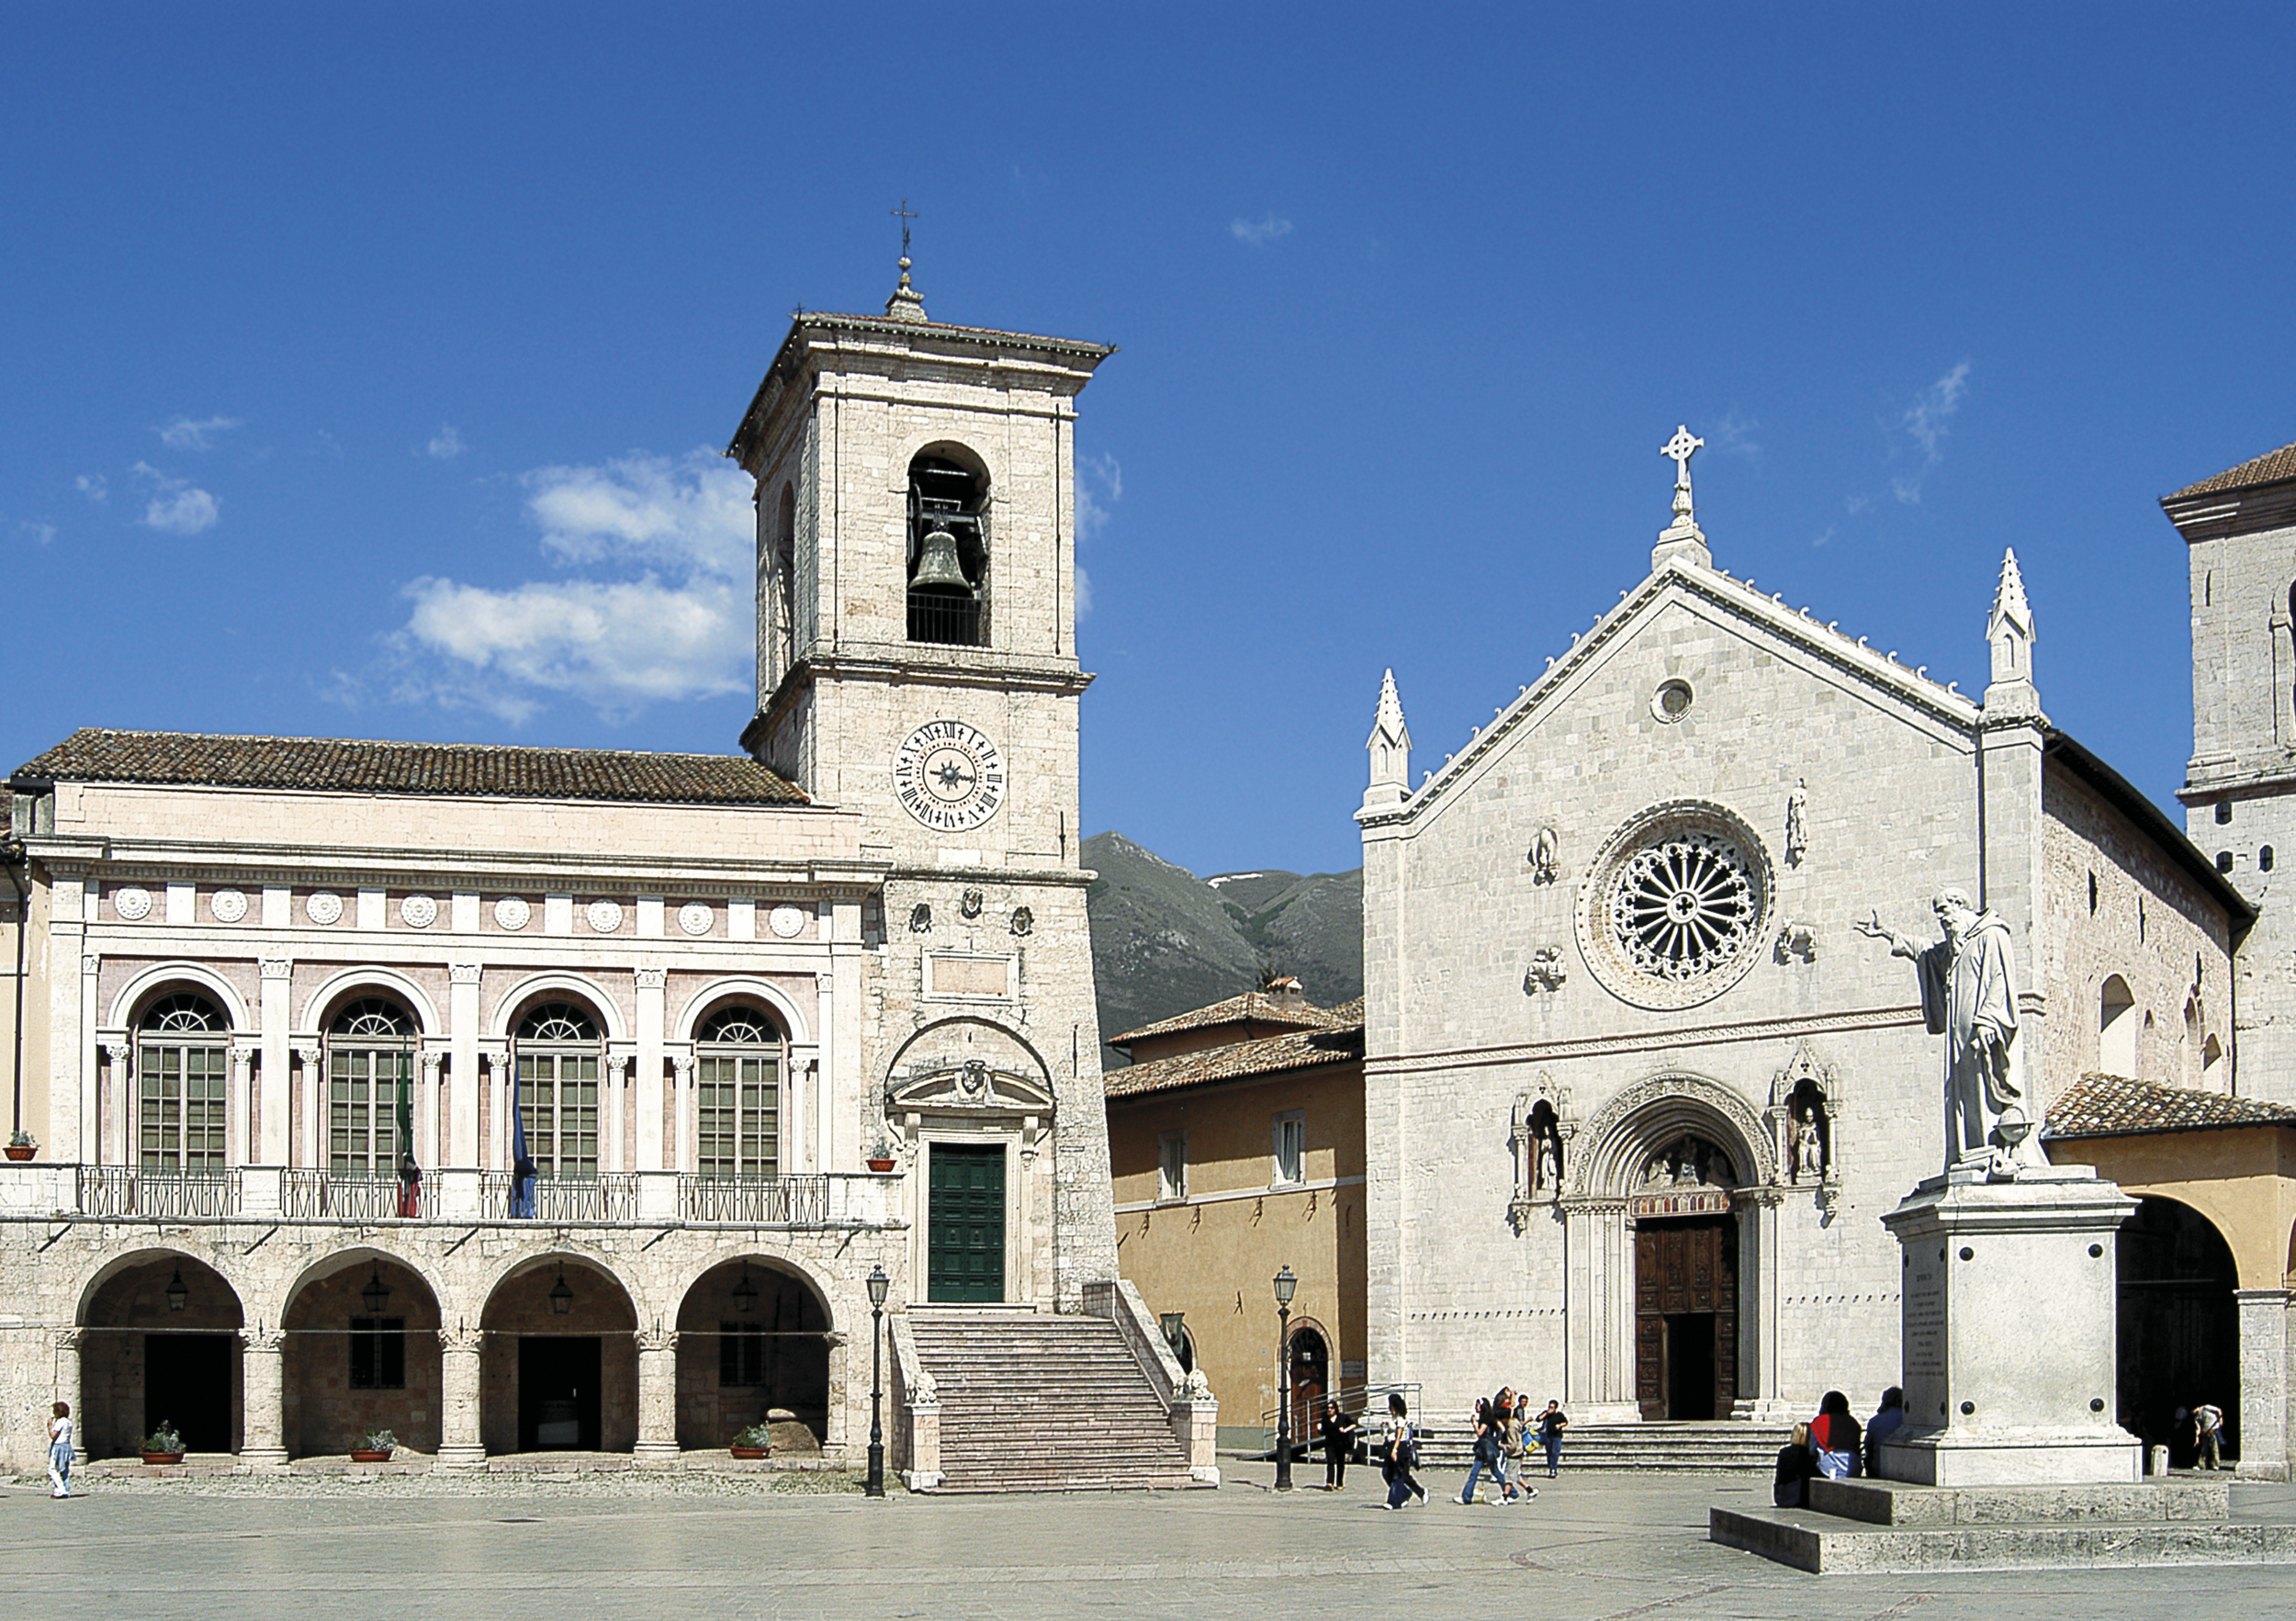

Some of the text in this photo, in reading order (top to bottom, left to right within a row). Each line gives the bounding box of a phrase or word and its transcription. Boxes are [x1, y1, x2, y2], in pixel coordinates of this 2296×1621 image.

[918, 726, 934, 744] XI
[943, 722, 955, 738] XII
[967, 730, 977, 744] I
[902, 742, 919, 757] X
[981, 749, 996, 760] II
[896, 764, 912, 776] IX
[986, 774, 1002, 782] III
[902, 788, 918, 807] VIII
[919, 804, 933, 823] VII
[944, 812, 955, 827] VI
[968, 810, 980, 824] V
